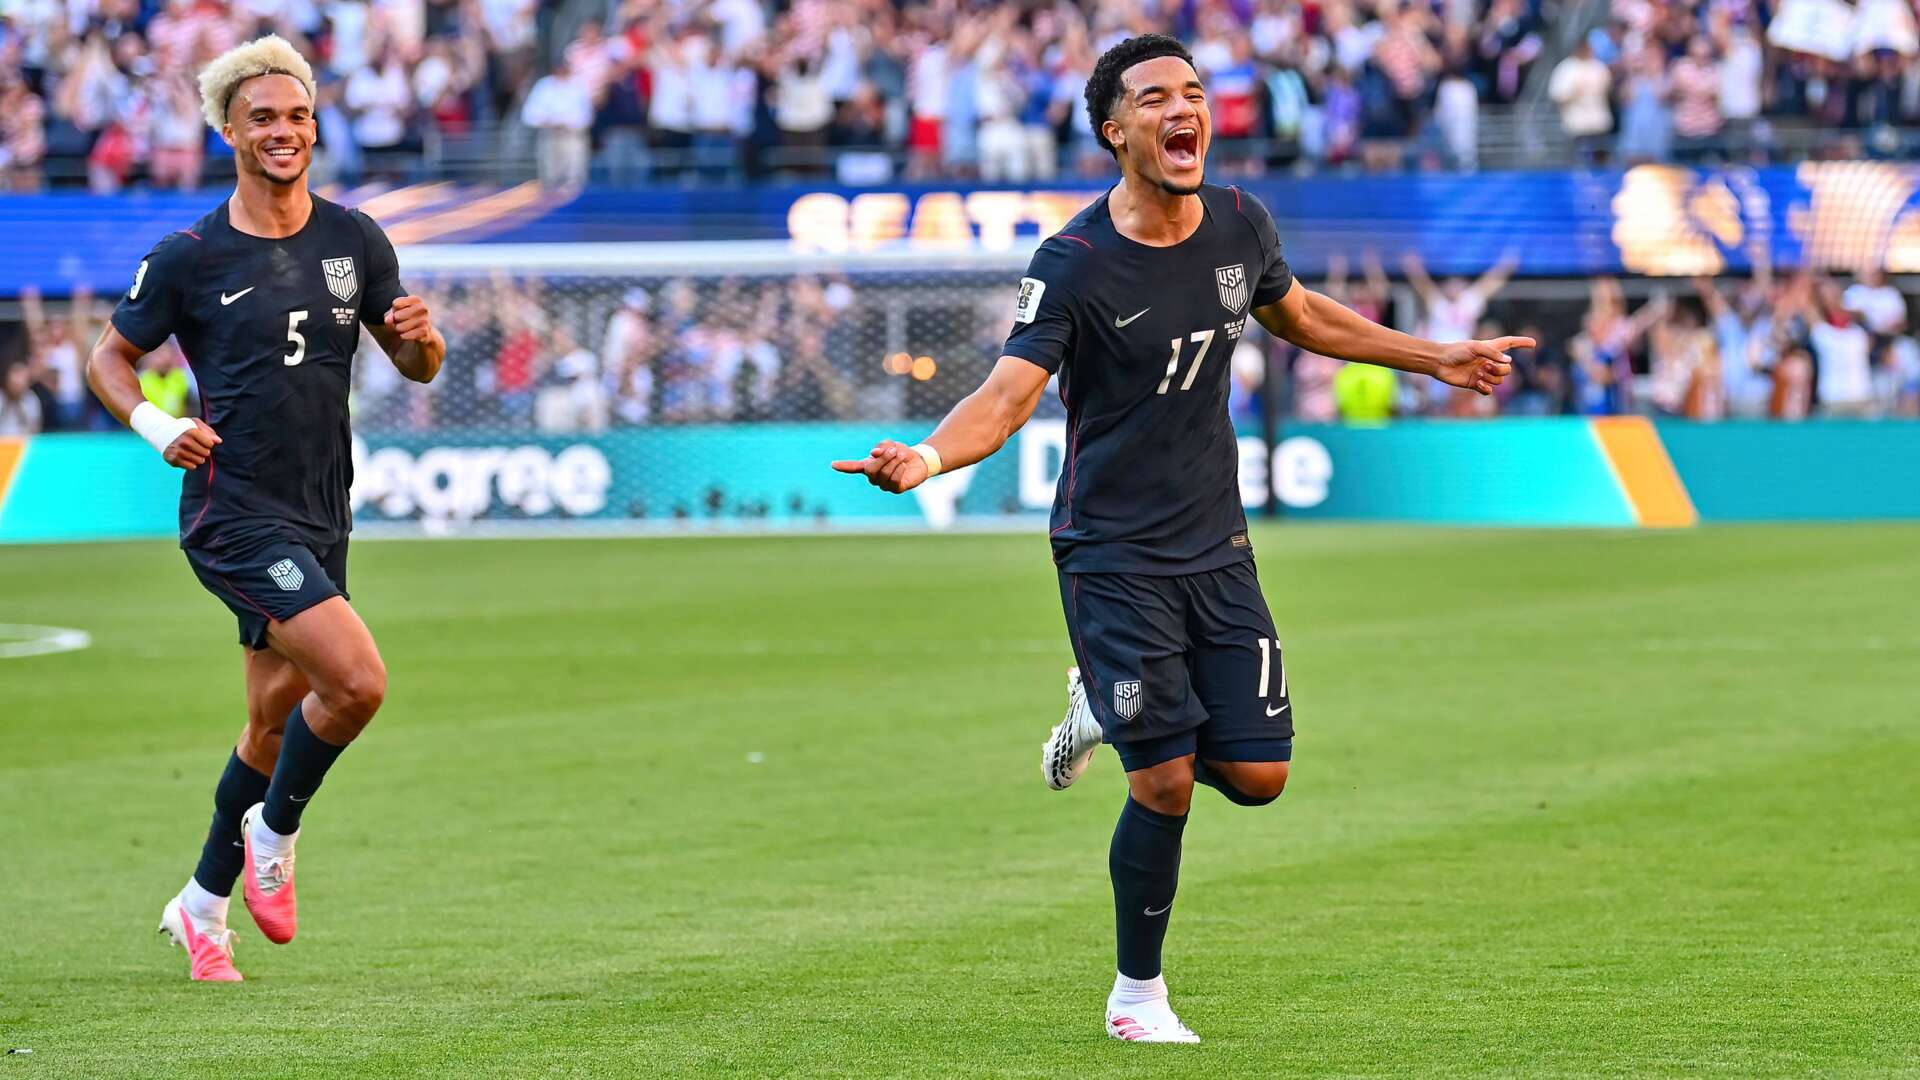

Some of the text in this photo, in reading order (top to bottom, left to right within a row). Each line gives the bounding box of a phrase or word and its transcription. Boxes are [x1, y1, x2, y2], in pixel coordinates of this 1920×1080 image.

[325, 260, 352, 277] USA
[1219, 268, 1243, 287] USA
[284, 310, 308, 366] 5
[1157, 330, 1215, 394] 17
[351, 431, 612, 534] egree
[271, 560, 293, 577] USA
[1117, 682, 1139, 698] USA
